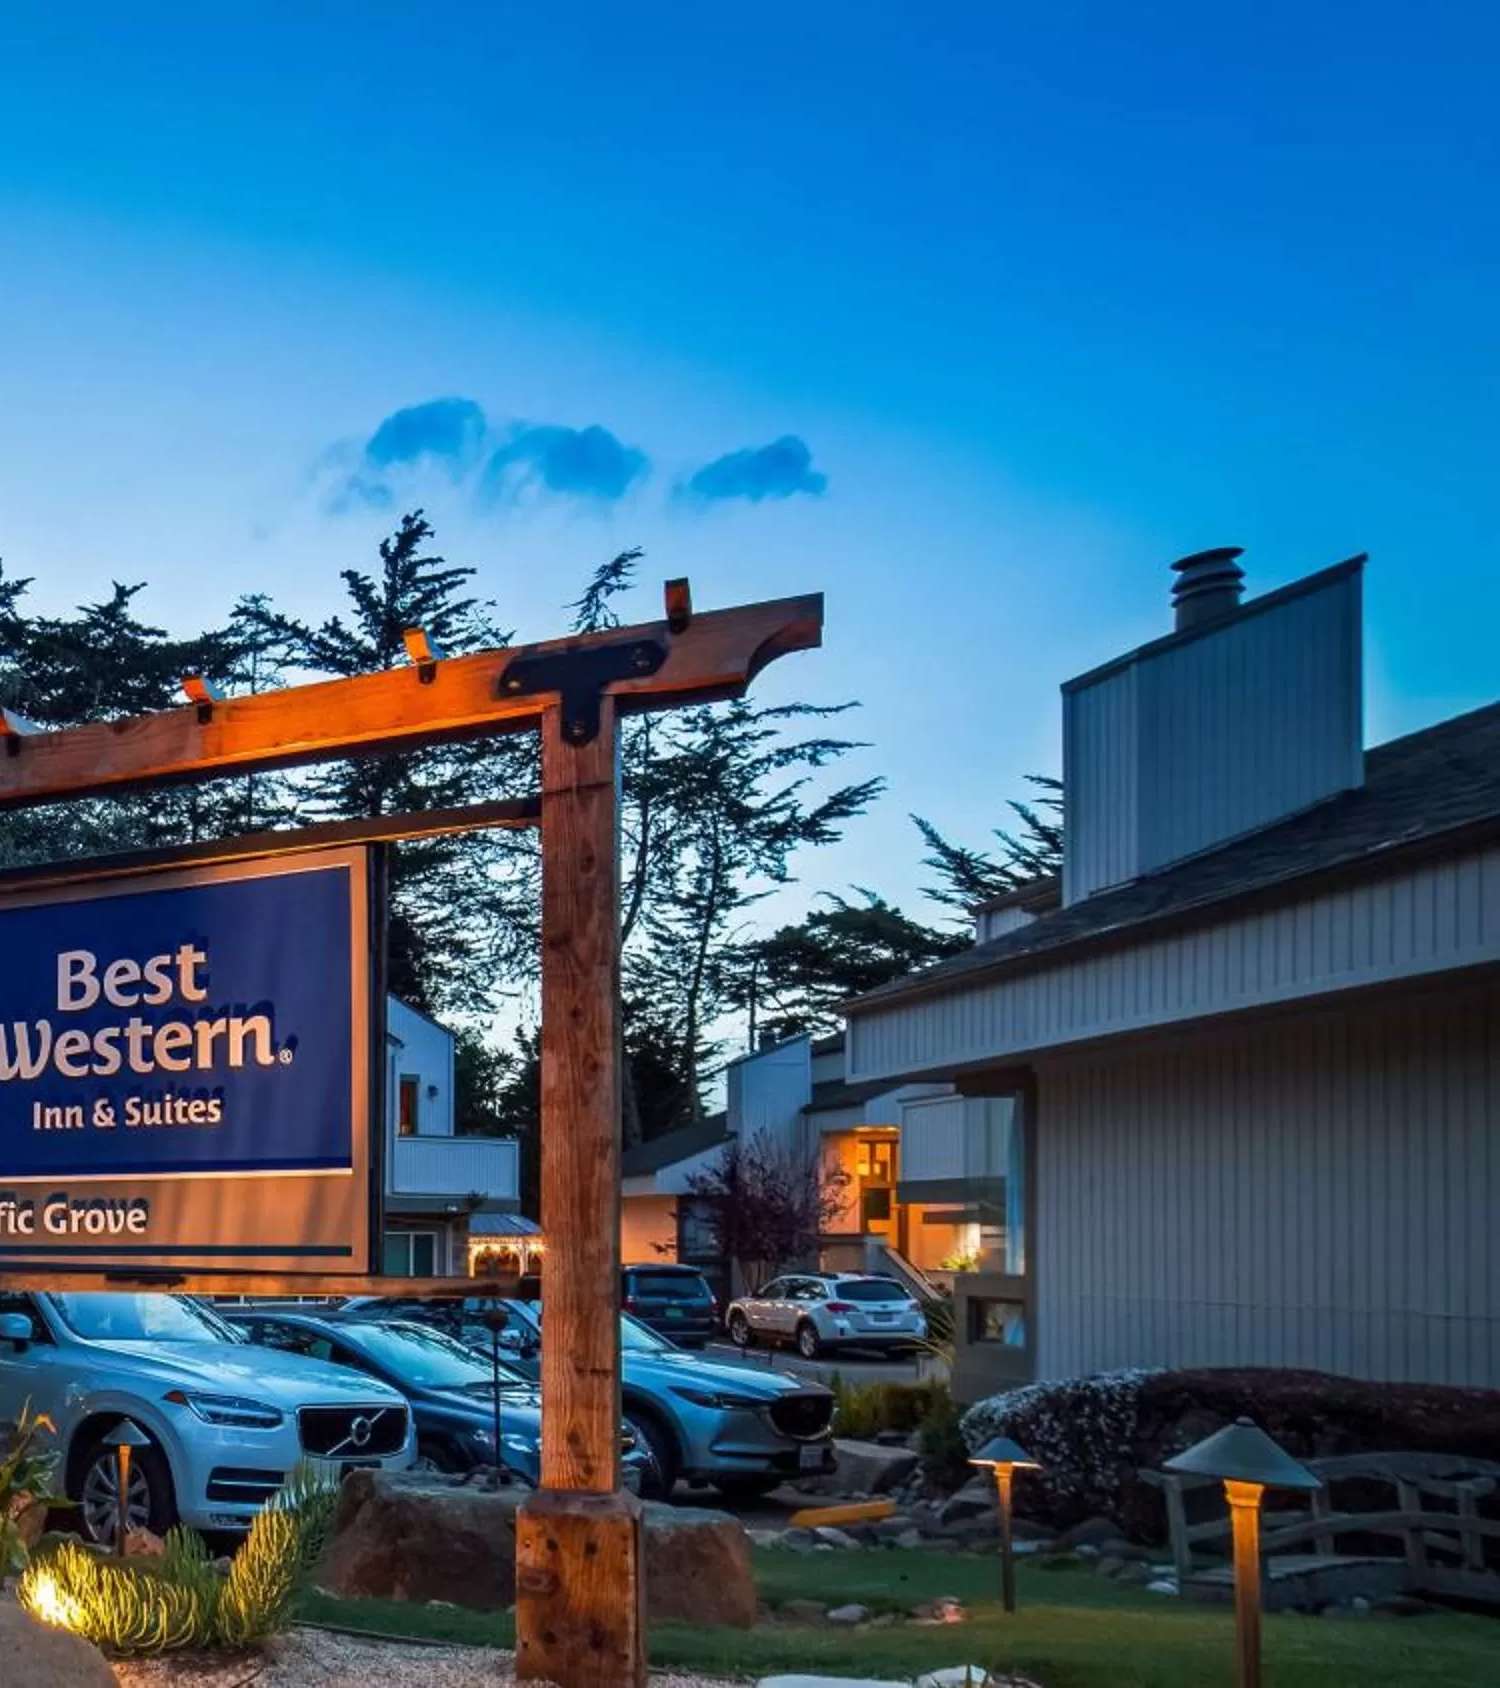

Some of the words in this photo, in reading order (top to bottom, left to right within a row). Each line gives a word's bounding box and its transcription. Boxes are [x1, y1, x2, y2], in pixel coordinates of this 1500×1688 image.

[56, 943, 207, 1011] Best
[33, 1102, 84, 1129] Inn
[93, 1099, 116, 1128] &
[125, 1096, 222, 1126] Suites
[43, 1201, 147, 1234] Grove
